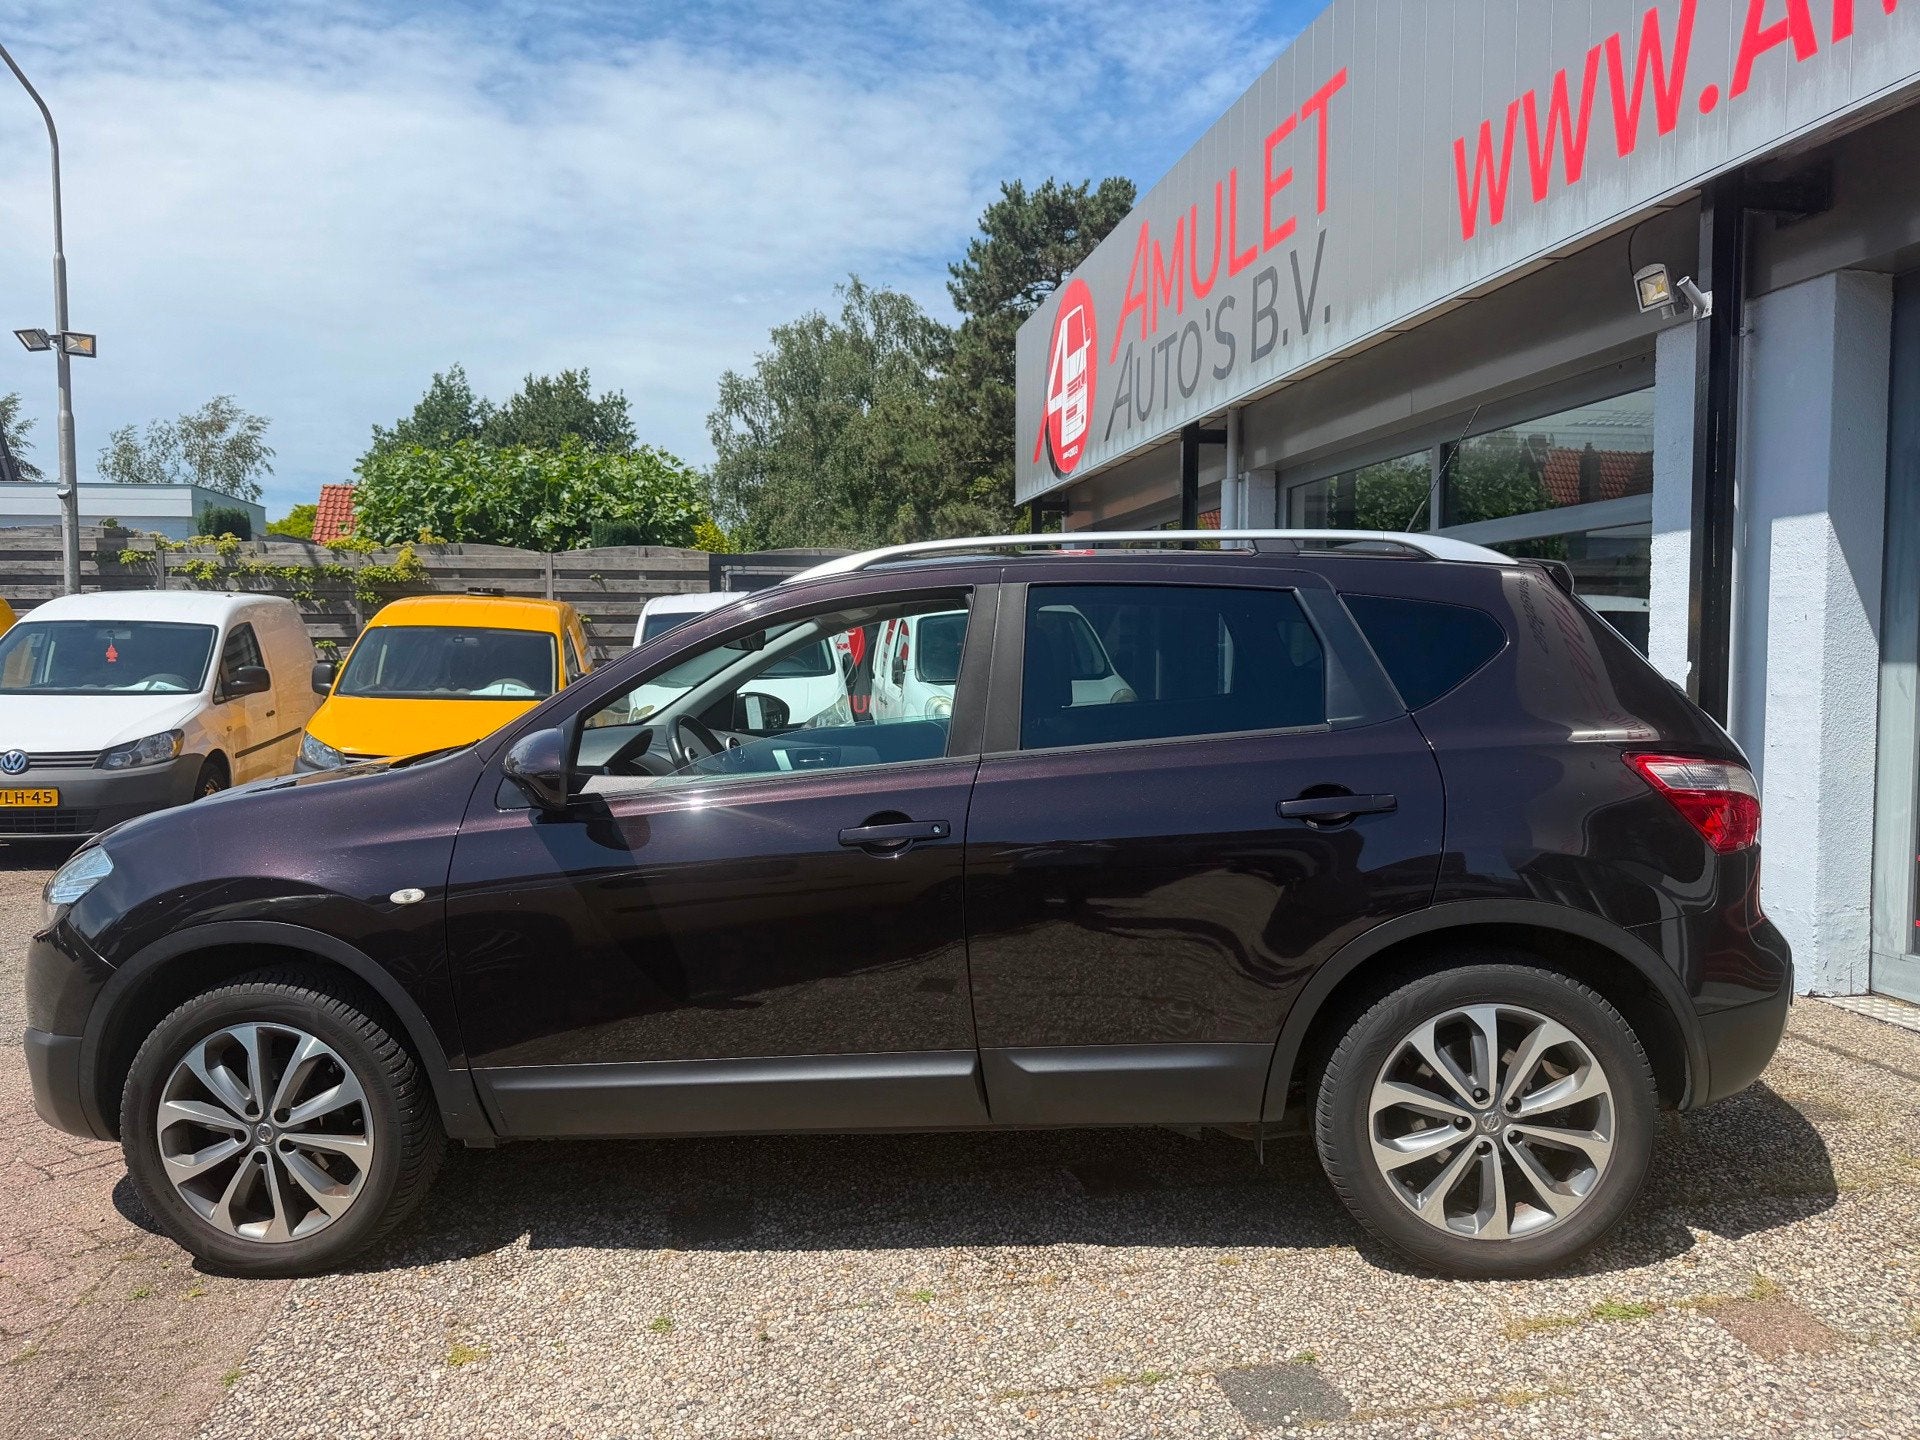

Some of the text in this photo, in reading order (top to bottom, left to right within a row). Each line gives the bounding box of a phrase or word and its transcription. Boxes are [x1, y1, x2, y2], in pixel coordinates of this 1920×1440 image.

[1109, 66, 1347, 366] AMULET
[1453, 0, 1902, 242] WWW.A
[1104, 228, 1331, 441] AUTO'S B.V.
